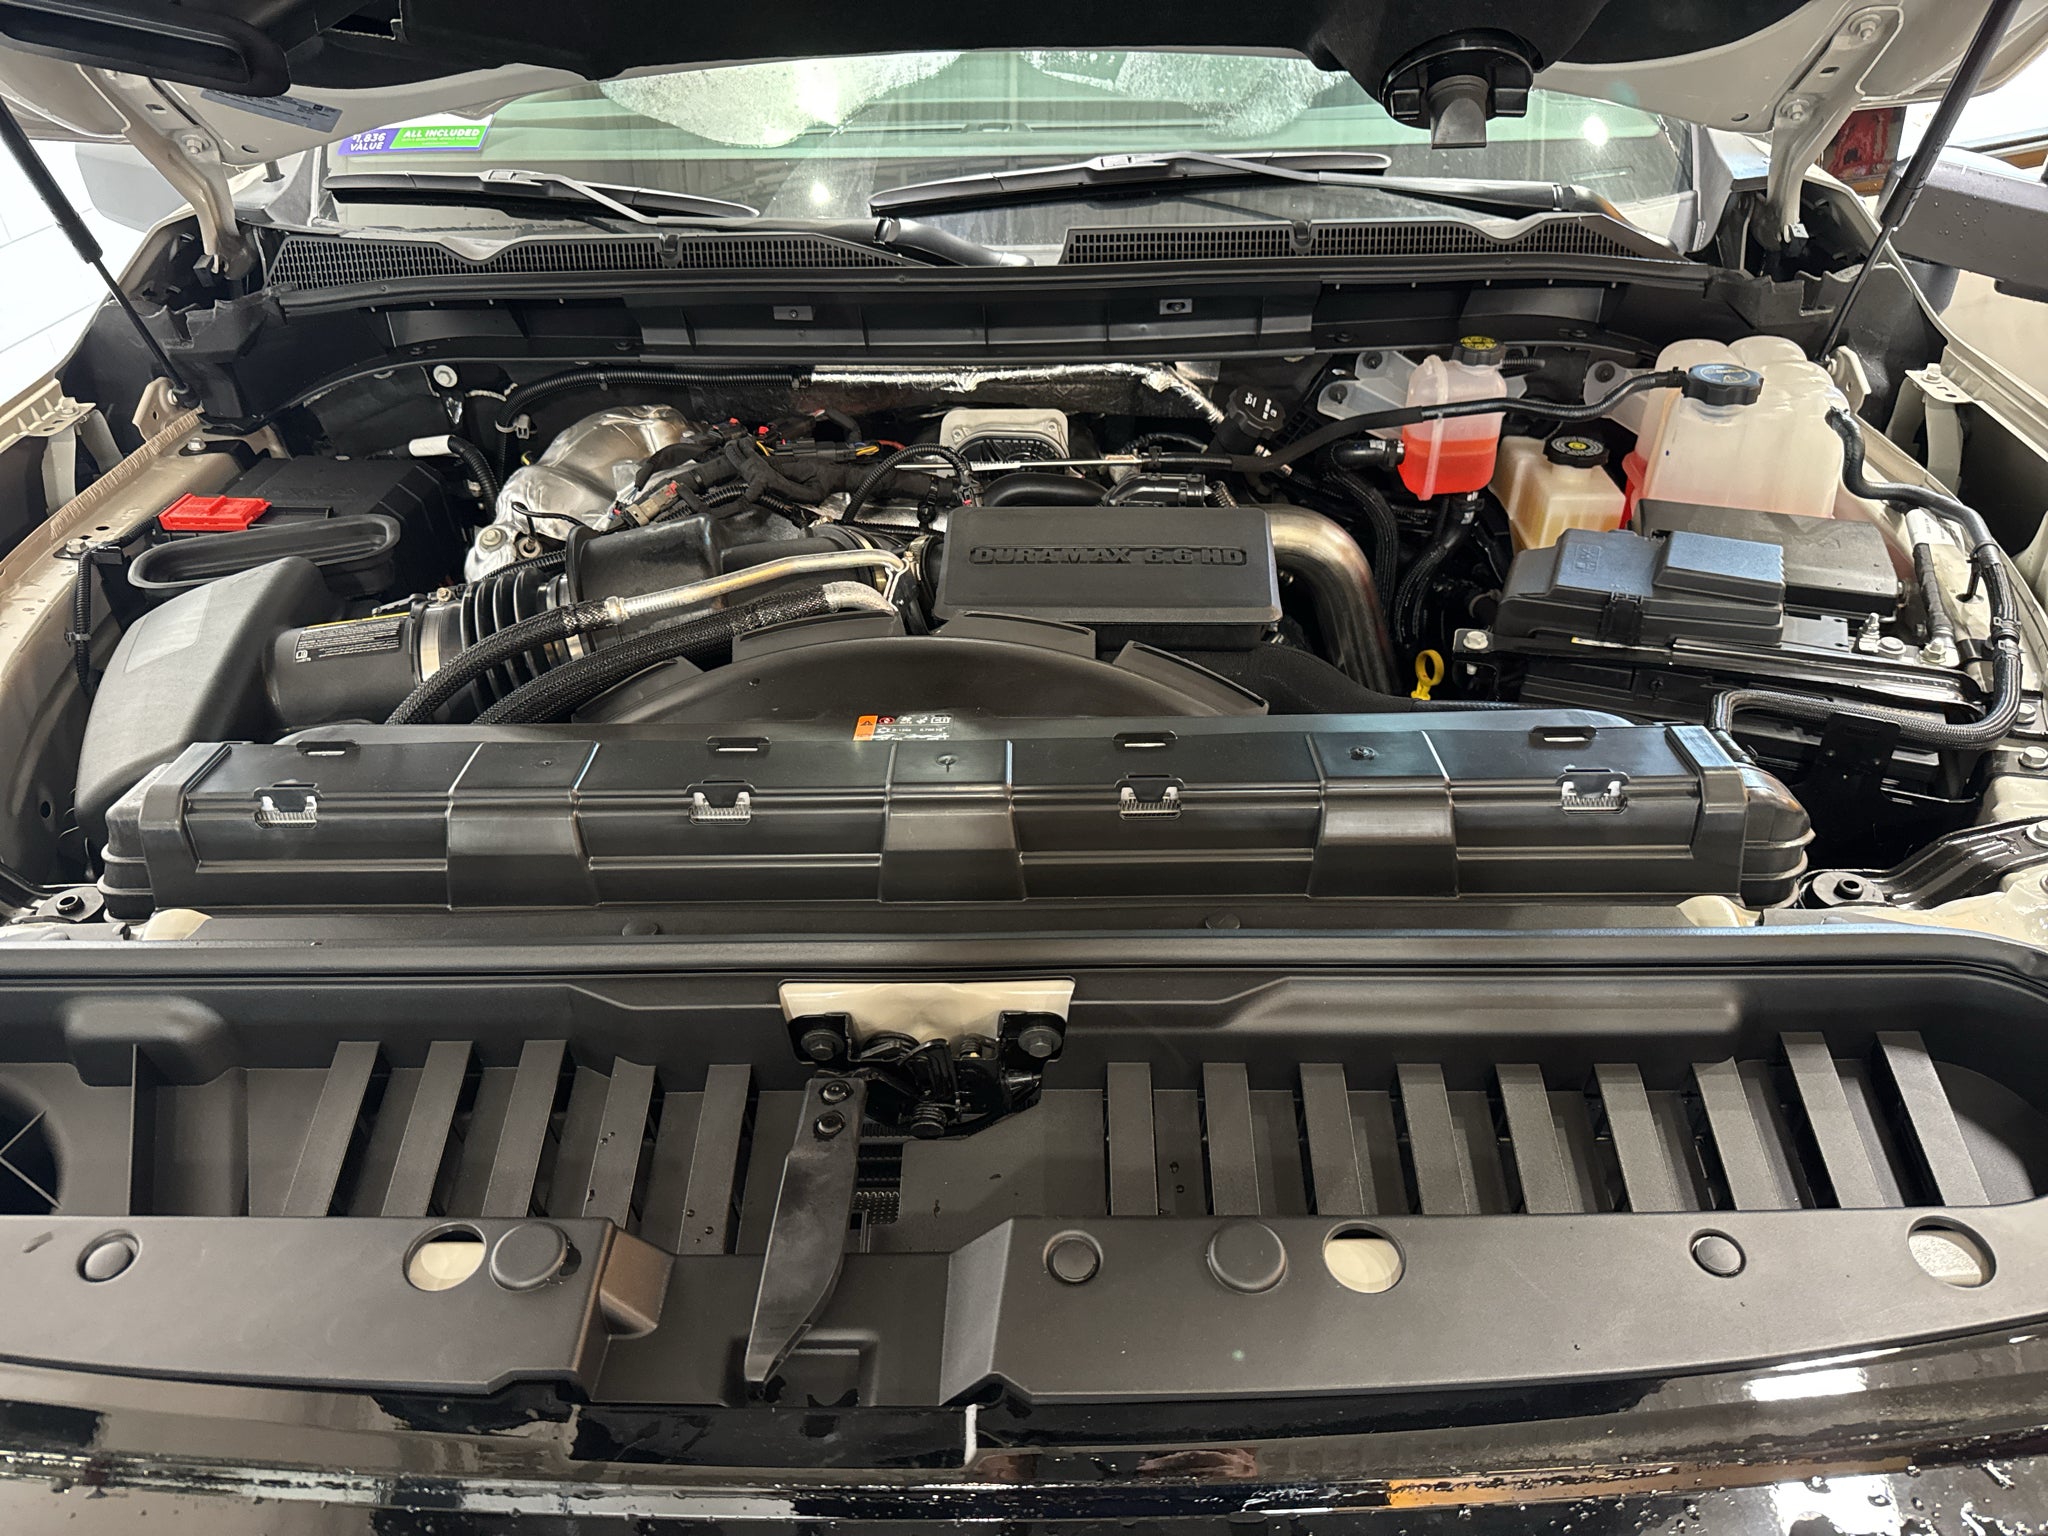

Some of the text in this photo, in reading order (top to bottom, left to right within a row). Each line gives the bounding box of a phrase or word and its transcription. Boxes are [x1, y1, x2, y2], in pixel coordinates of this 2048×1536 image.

[403, 128, 481, 138] ALL INCLUDED
[350, 141, 385, 152] VALUE
[971, 547, 1246, 565] DURAMAX 6.6 HD
